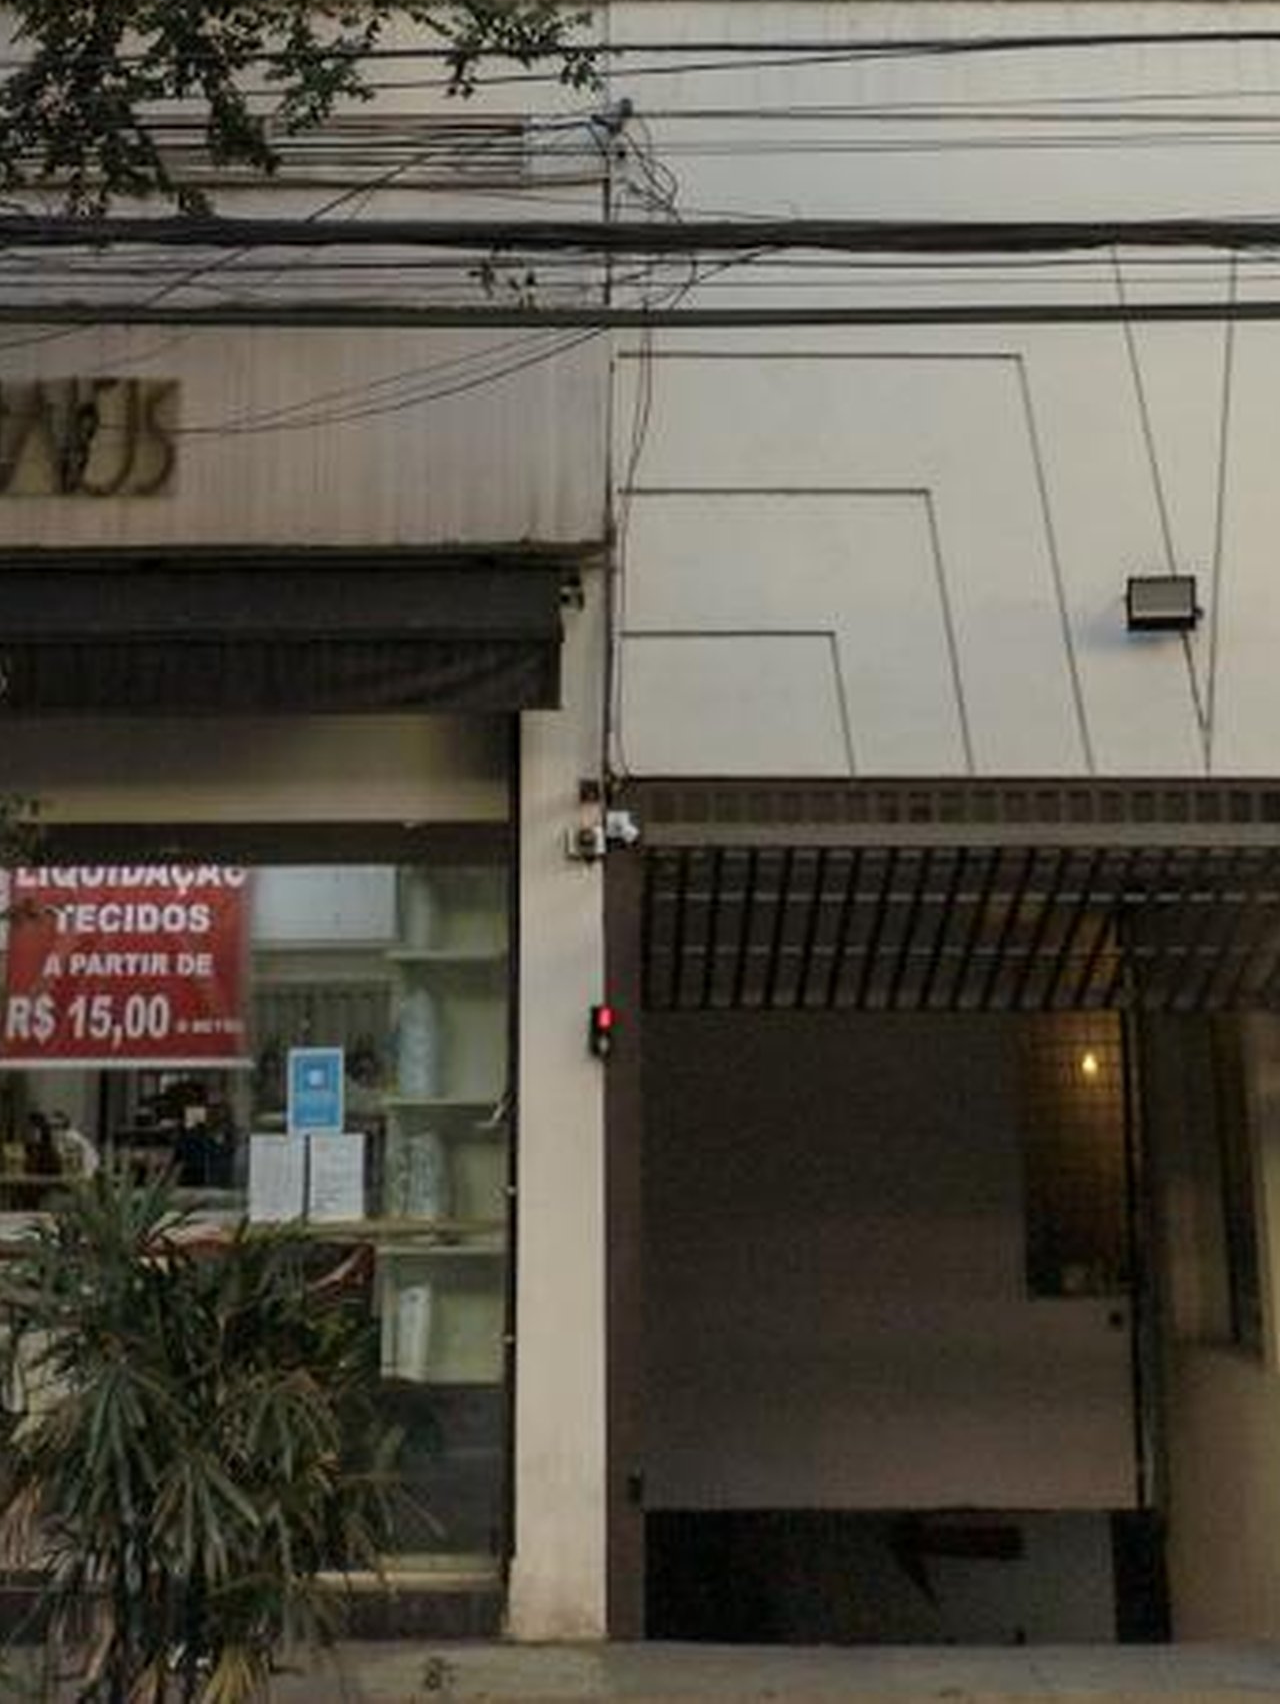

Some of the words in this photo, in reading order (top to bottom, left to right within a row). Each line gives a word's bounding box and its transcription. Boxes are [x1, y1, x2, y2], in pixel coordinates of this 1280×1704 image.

[51, 903, 211, 934] TECIDOS
[42, 953, 62, 978] A
[70, 952, 170, 977] PARTIR
[176, 951, 213, 976] DE
[7, 993, 56, 1044] R$
[68, 993, 170, 1050] 15,00
